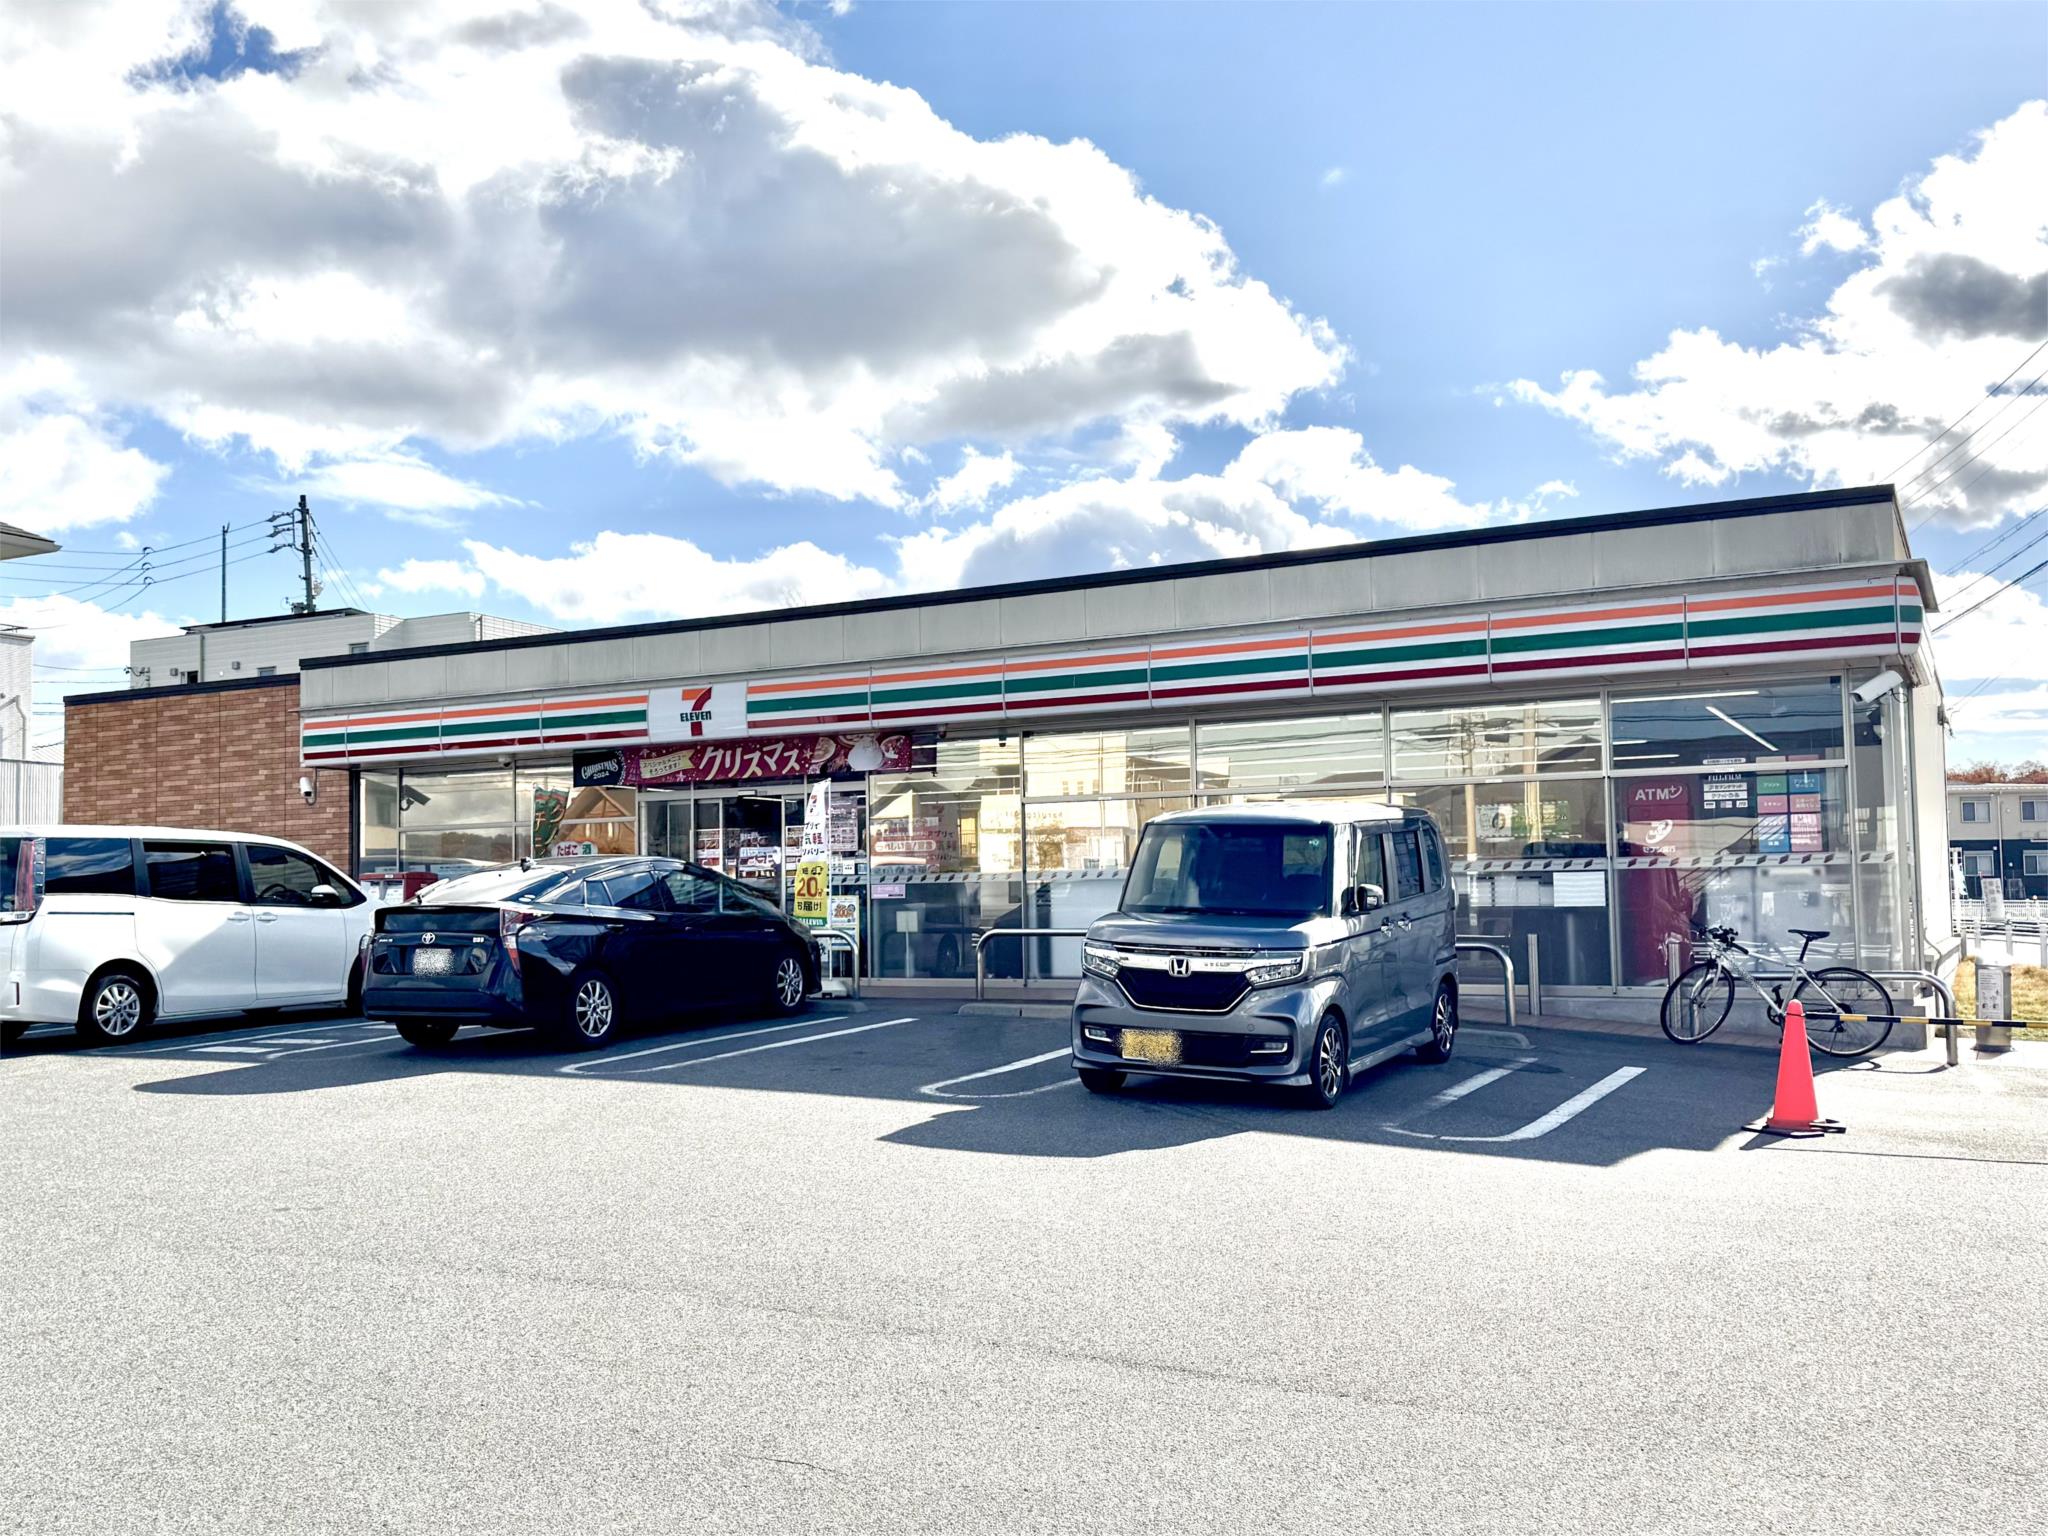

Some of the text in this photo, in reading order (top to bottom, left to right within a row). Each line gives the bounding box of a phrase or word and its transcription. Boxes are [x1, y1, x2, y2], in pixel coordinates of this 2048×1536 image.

[699, 741, 801, 780] クリスマス
[581, 760, 619, 779] CHRISTMAS
[593, 770, 610, 780] 2024
[1635, 788, 1669, 801] ATM
[557, 844, 578, 857] たばこ
[582, 843, 592, 855] 酒
